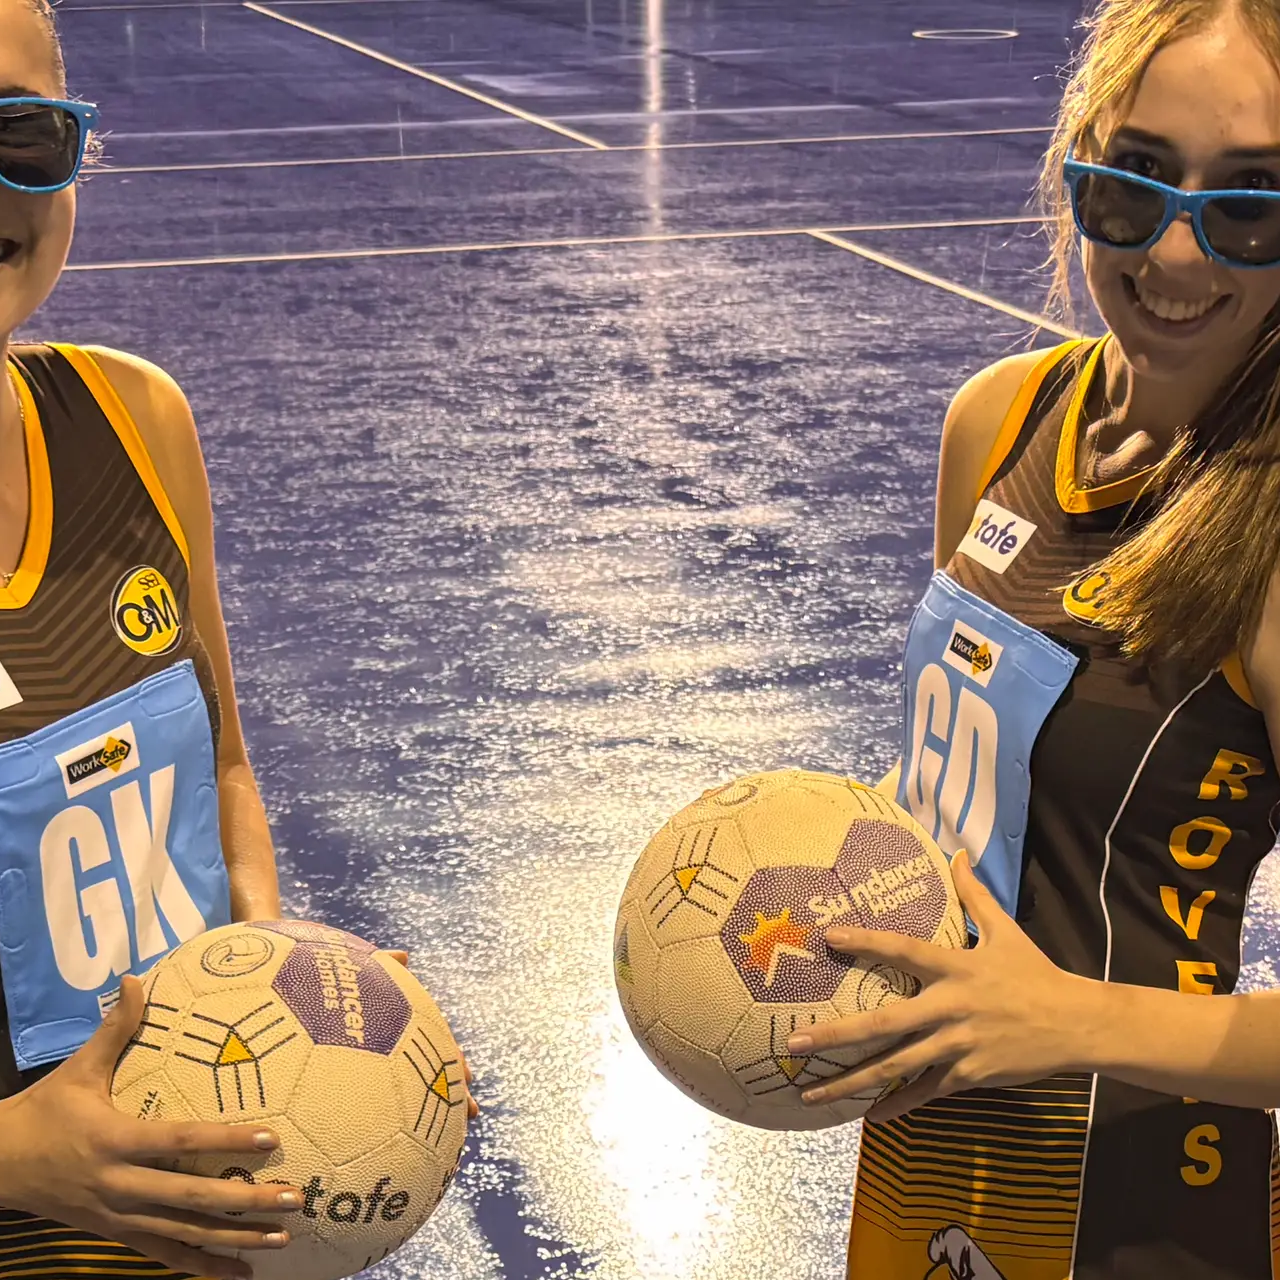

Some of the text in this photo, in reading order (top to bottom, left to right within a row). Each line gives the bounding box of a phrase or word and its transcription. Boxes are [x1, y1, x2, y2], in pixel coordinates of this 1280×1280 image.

[907, 663, 998, 868] GD
[39, 763, 206, 990] GK
[807, 853, 933, 927] Sundancer
[1160, 748, 1265, 1187] ROVES
[220, 1167, 410, 1223] tafe
